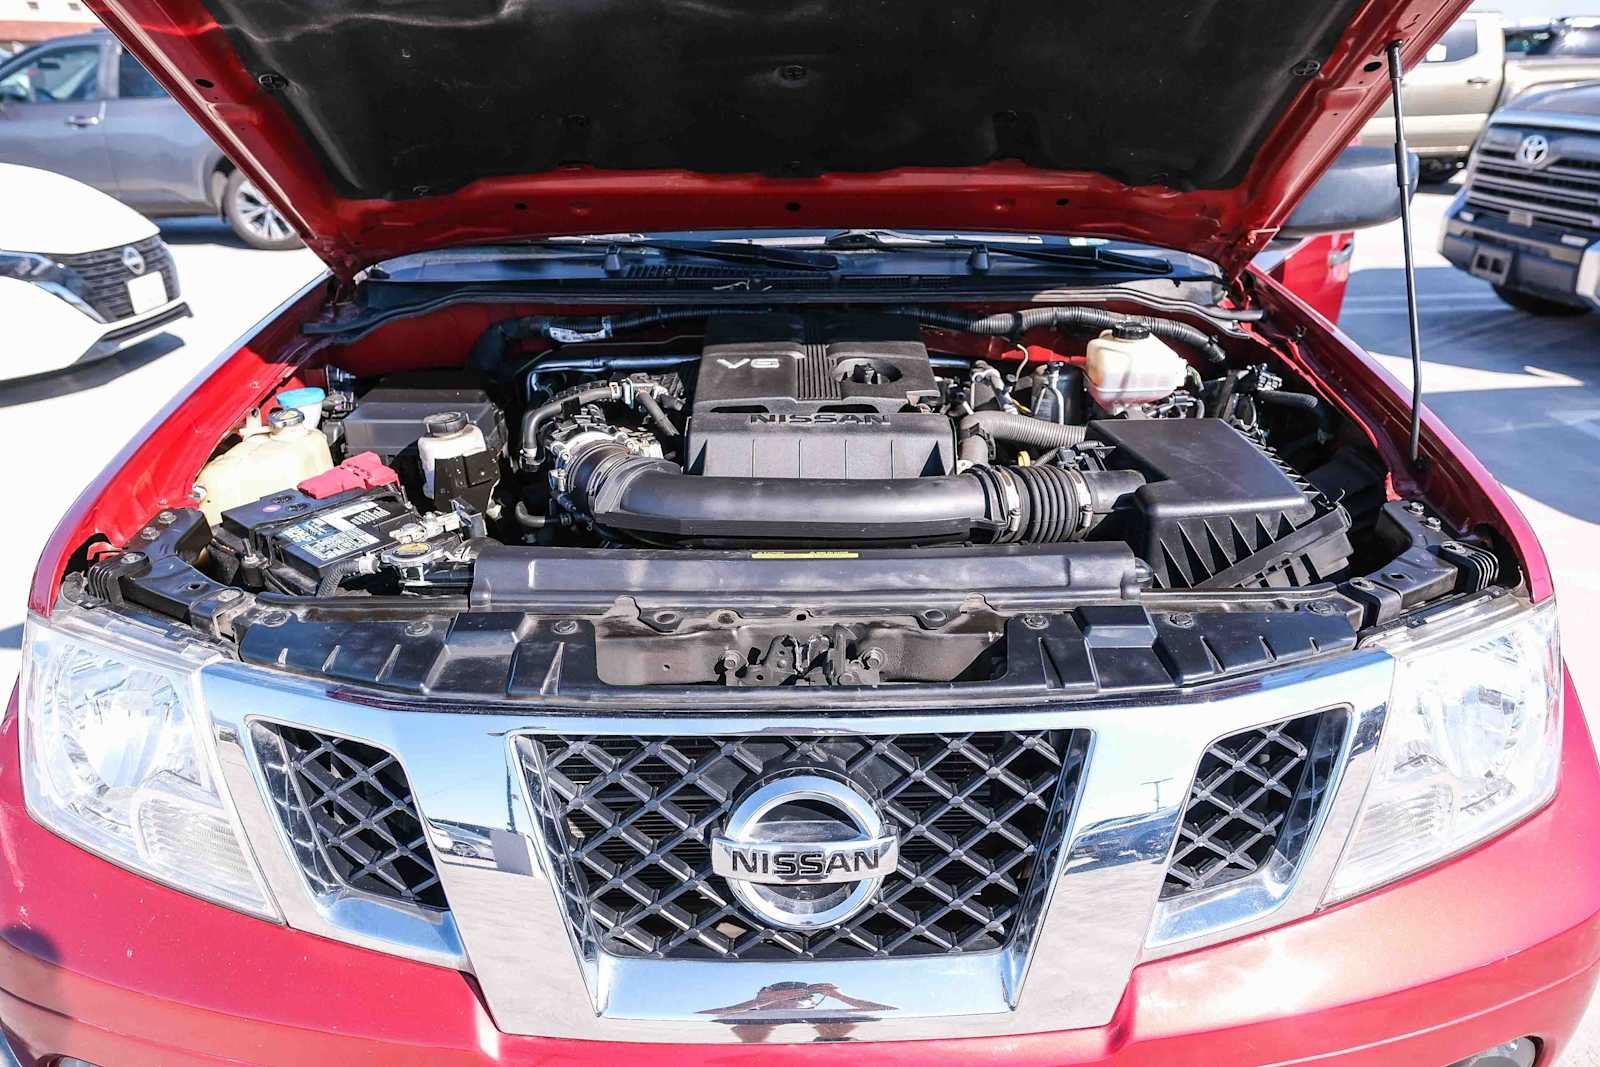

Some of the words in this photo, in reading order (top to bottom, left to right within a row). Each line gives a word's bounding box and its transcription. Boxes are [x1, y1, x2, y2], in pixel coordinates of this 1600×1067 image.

[715, 358, 780, 370] V6
[750, 413, 891, 426] NISSAN
[731, 849, 880, 877] NISSAN
